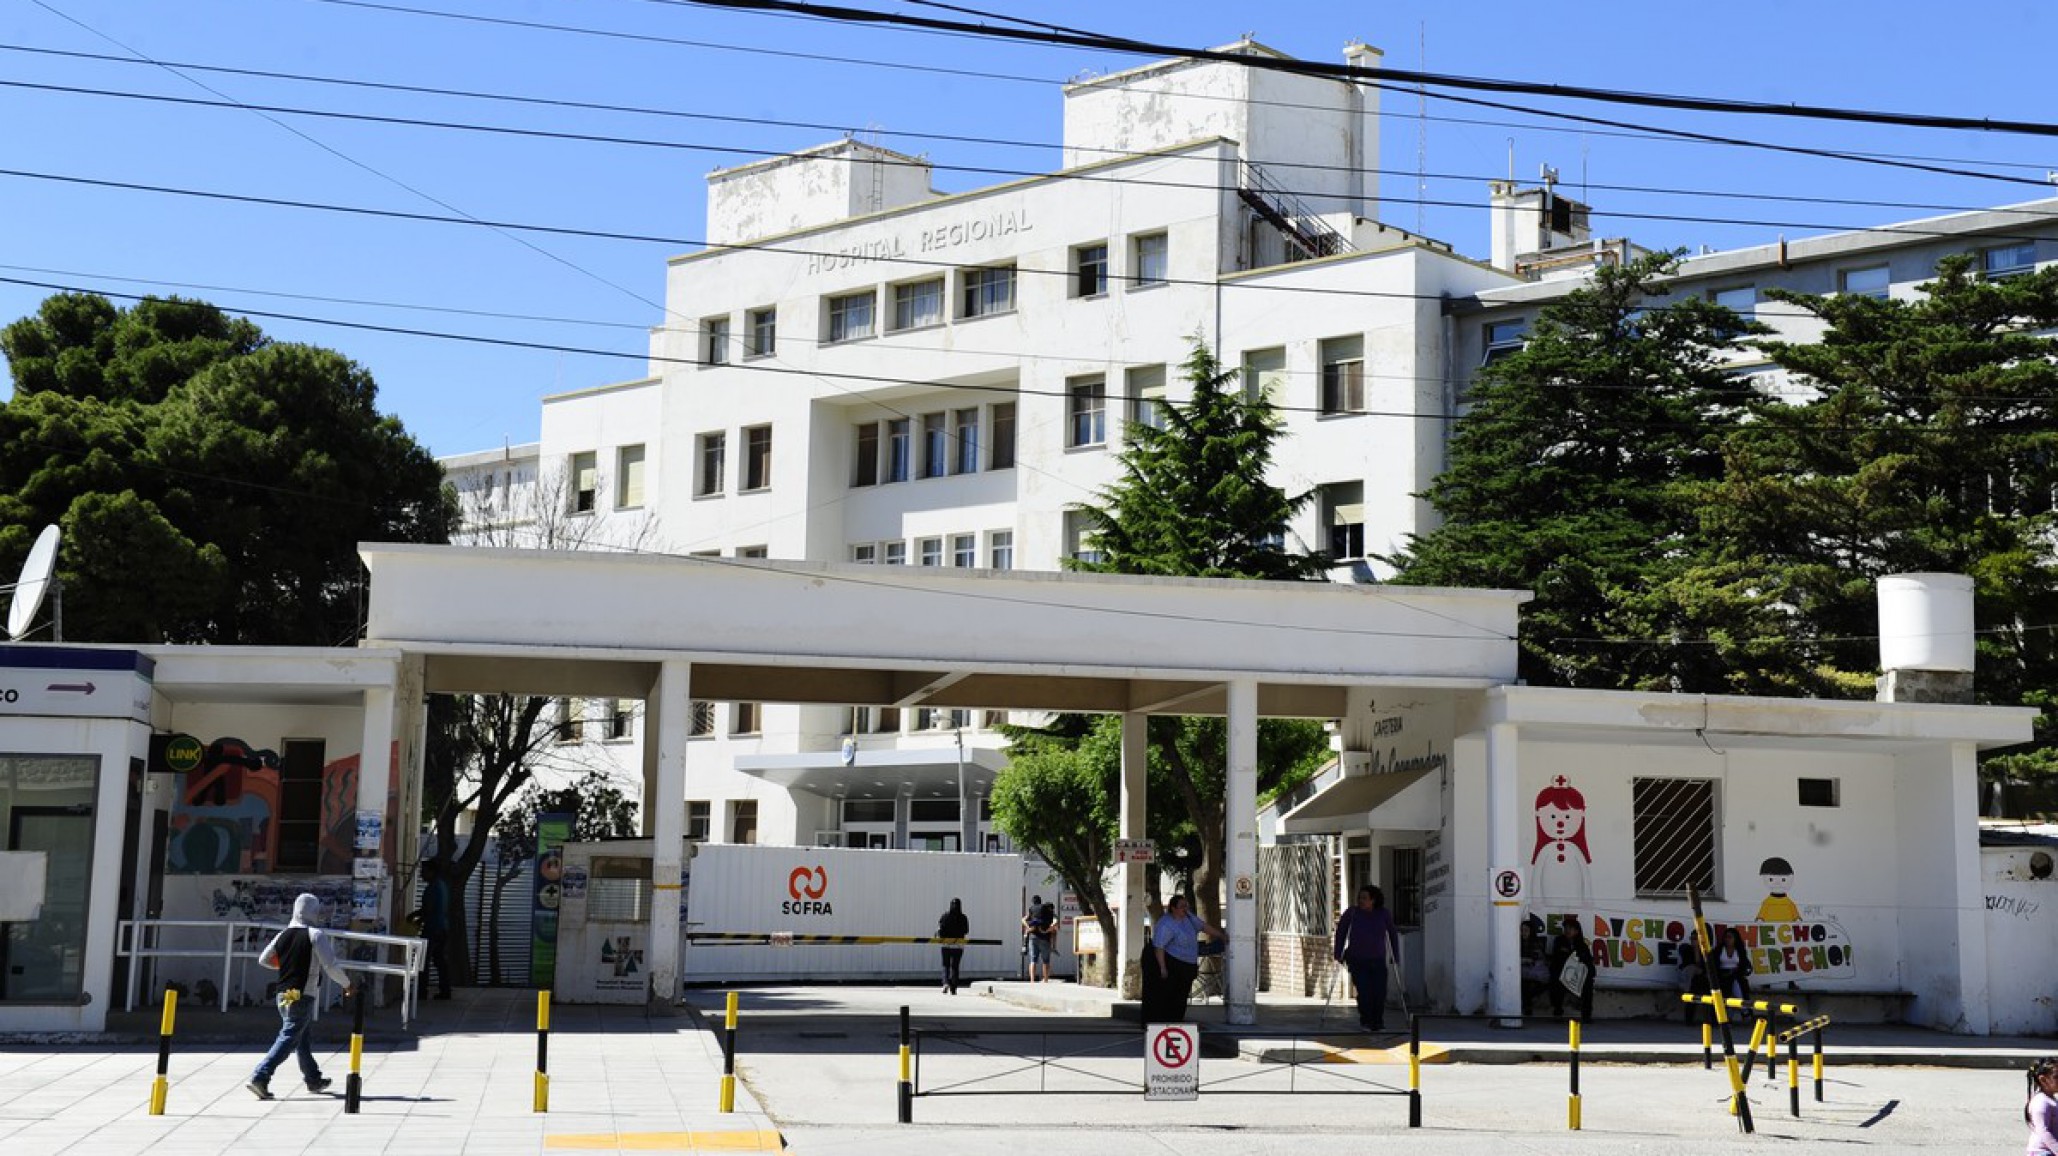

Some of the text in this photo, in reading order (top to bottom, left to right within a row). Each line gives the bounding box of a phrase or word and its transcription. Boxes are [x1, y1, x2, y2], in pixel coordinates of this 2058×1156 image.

[808, 209, 1034, 275] HOSPITAL REGIONAL
[169, 749, 200, 761] LINK
[782, 901, 833, 915] SOFRA
[1594, 914, 1685, 942] DICHO
[1583, 938, 1654, 968] ALUD
[1751, 944, 1852, 975] ERECHO!
[1166, 1037, 1182, 1059] E
[1151, 1074, 1193, 1083] PROHIBIDO
[1149, 1086, 1196, 1097] ESTACIONAR
